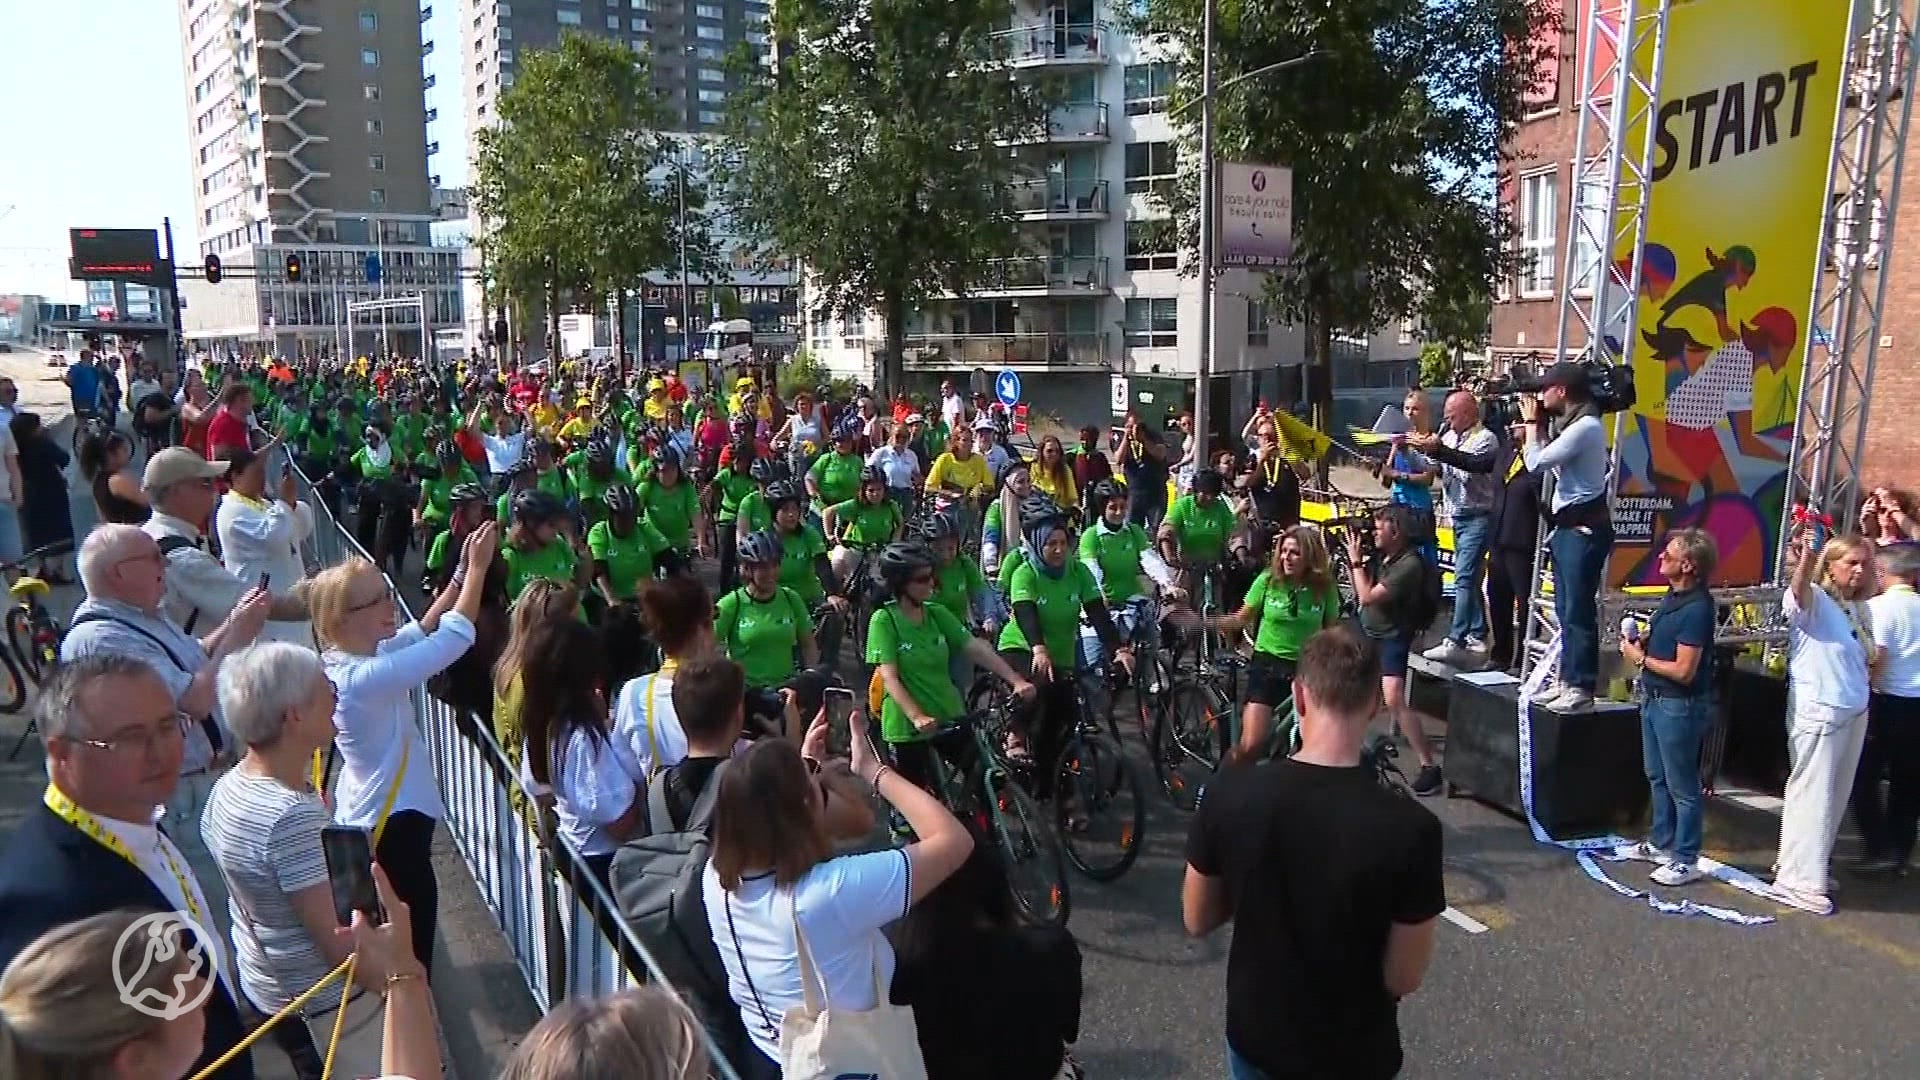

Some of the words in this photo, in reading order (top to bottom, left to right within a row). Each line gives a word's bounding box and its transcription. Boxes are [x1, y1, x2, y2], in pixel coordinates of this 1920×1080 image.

[1650, 59, 1818, 182] START
[1614, 510, 1641, 522] MAKE
[1643, 511, 1653, 522] IT
